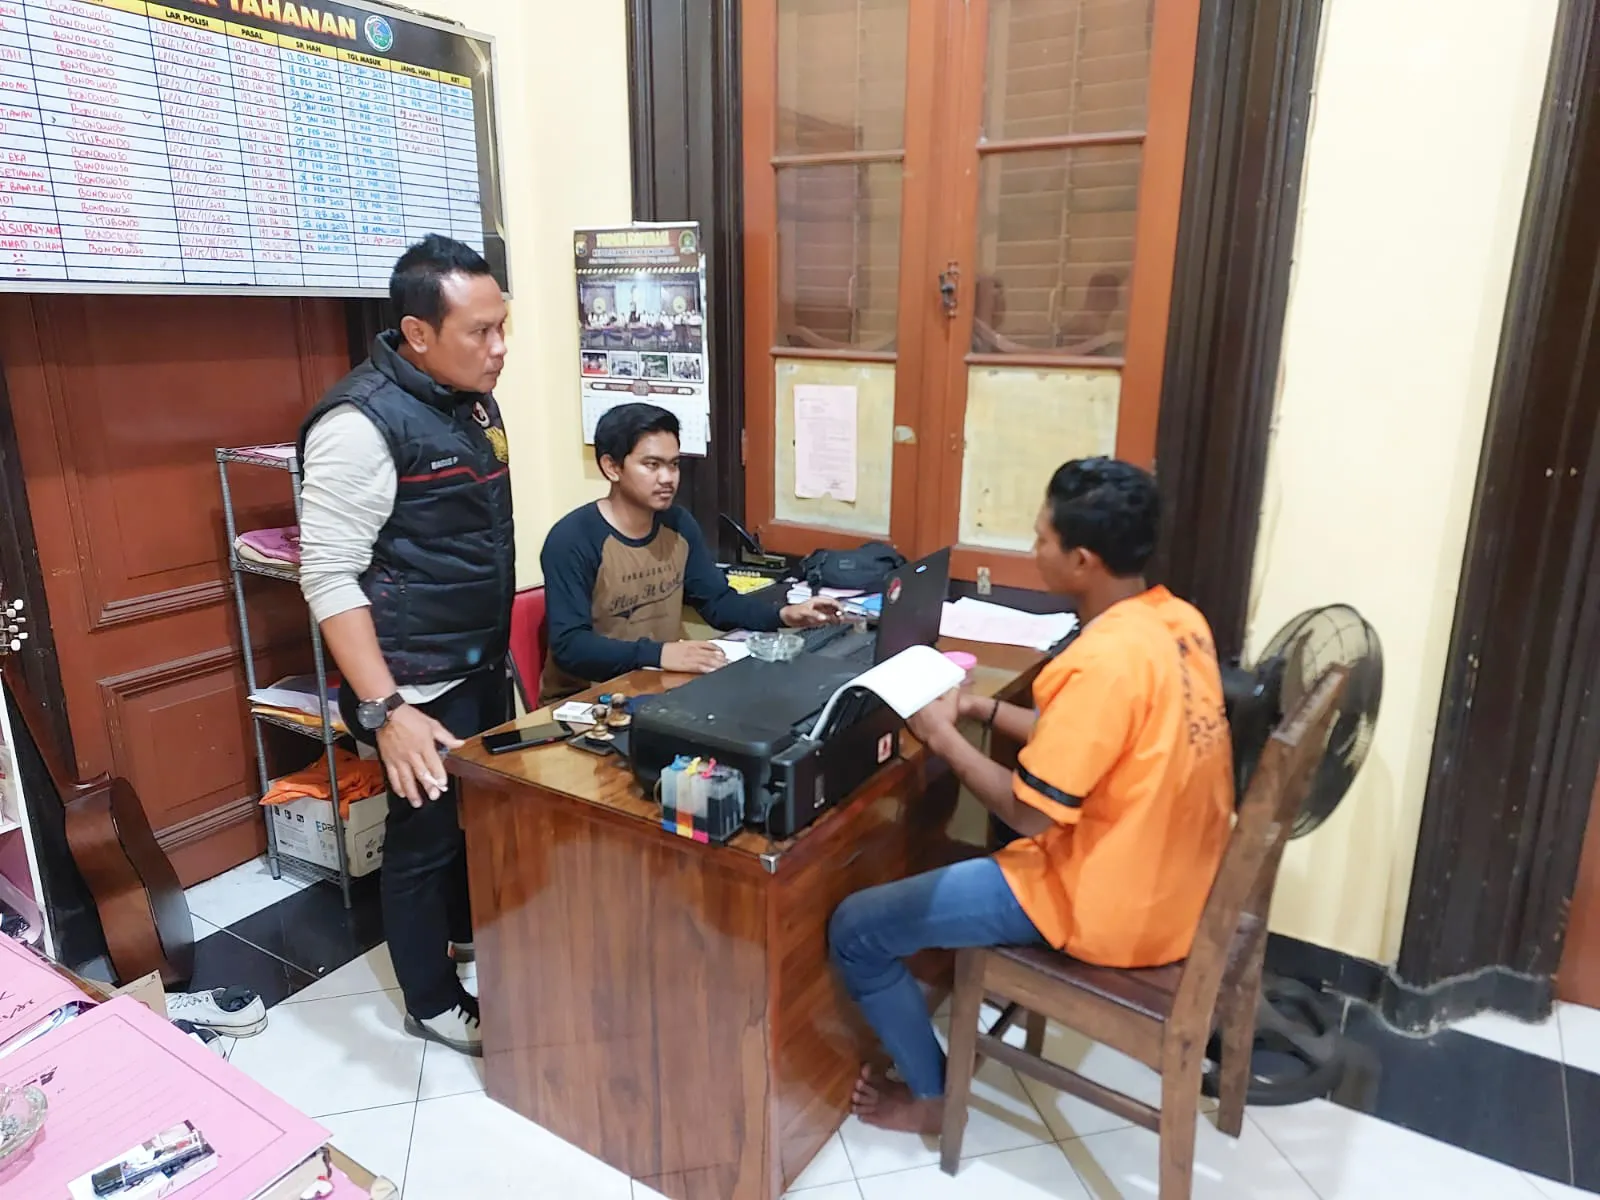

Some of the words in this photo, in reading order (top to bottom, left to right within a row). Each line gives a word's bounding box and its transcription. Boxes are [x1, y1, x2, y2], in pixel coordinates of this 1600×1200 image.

[165, 10, 181, 20] LAR
[183, 14, 209, 27] POLISI
[228, 0, 357, 41] TAHANAN
[241, 29, 263, 40] PASAL
[360, 56, 381, 66] MASUK
